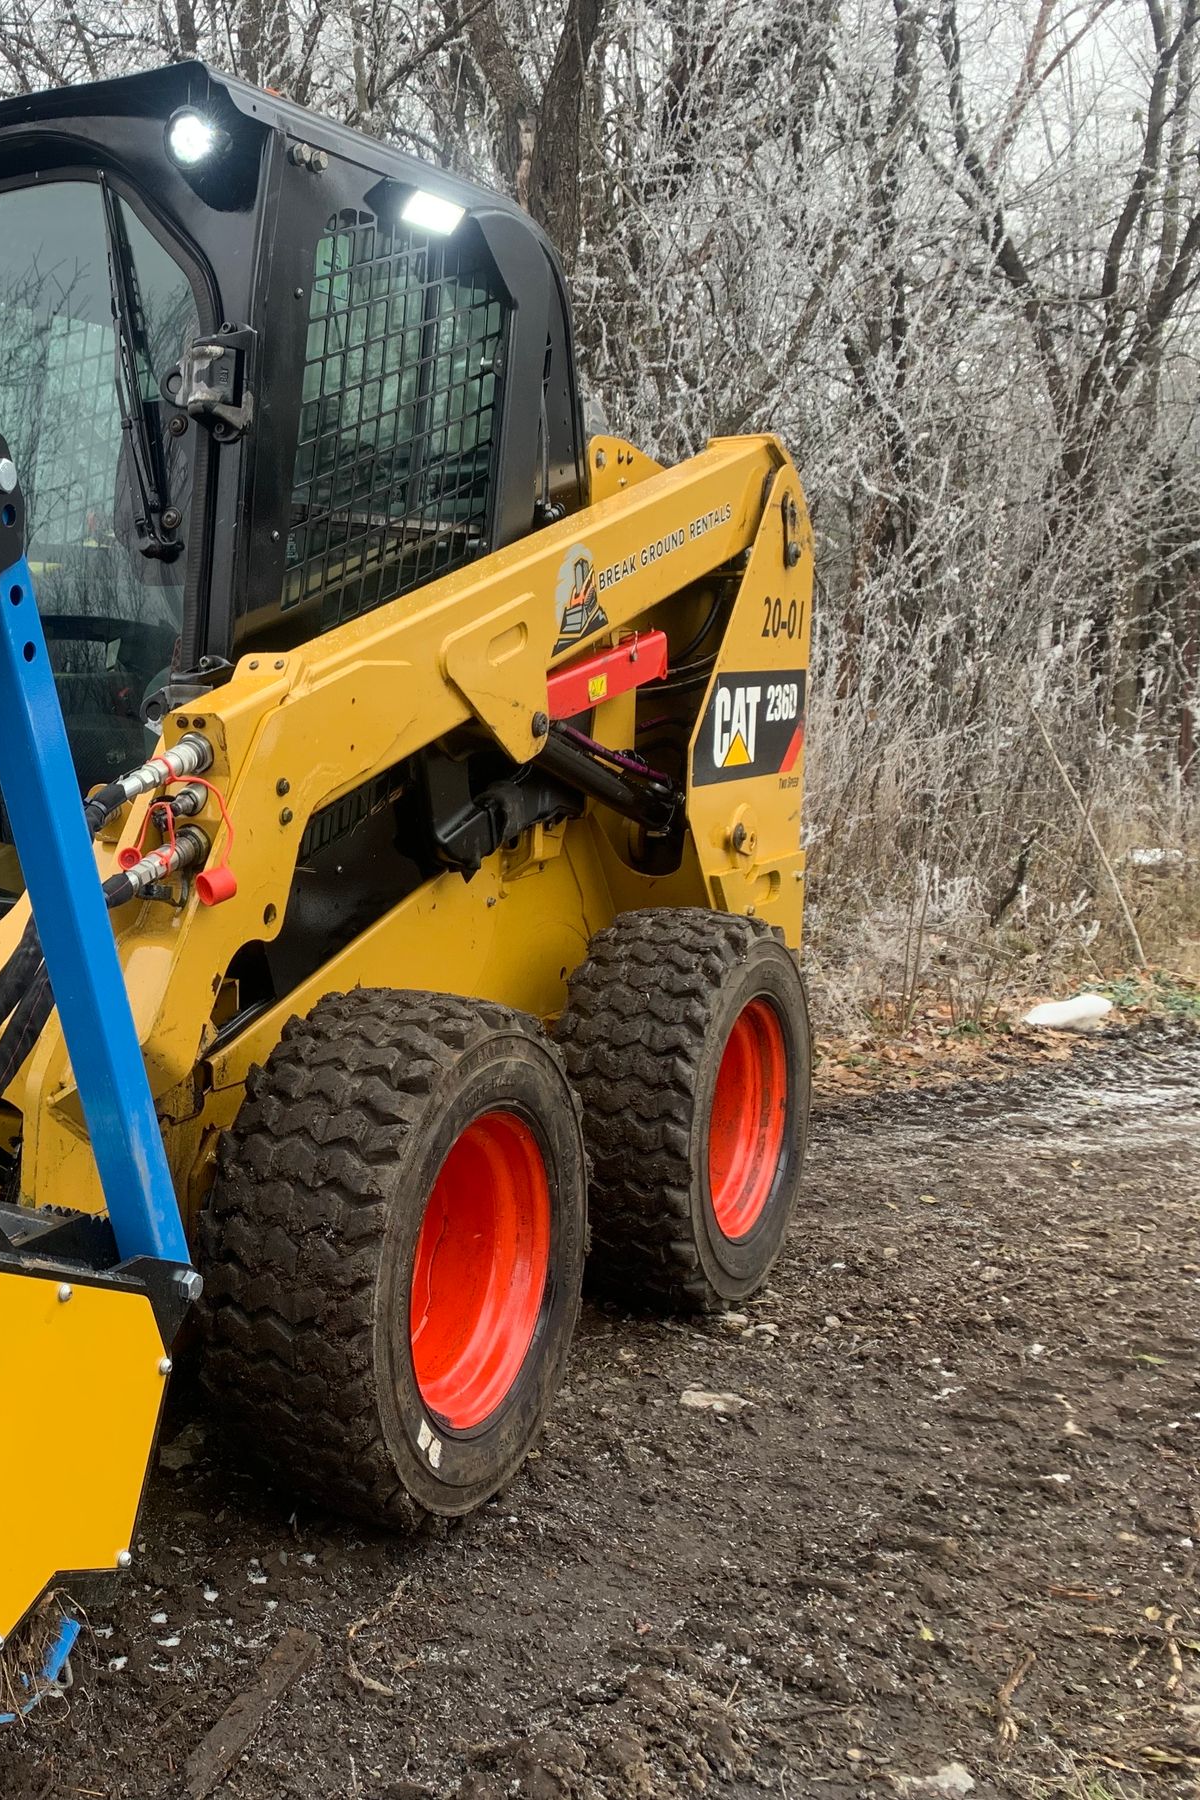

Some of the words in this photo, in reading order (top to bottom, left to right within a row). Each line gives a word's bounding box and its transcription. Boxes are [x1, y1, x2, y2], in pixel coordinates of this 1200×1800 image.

[598, 554, 637, 591] BREAK
[640, 528, 685, 567] GROUND
[689, 503, 732, 540] RENTALS
[761, 596, 804, 640] 20-01
[713, 686, 762, 768] CAT
[766, 683, 798, 722] 236D
